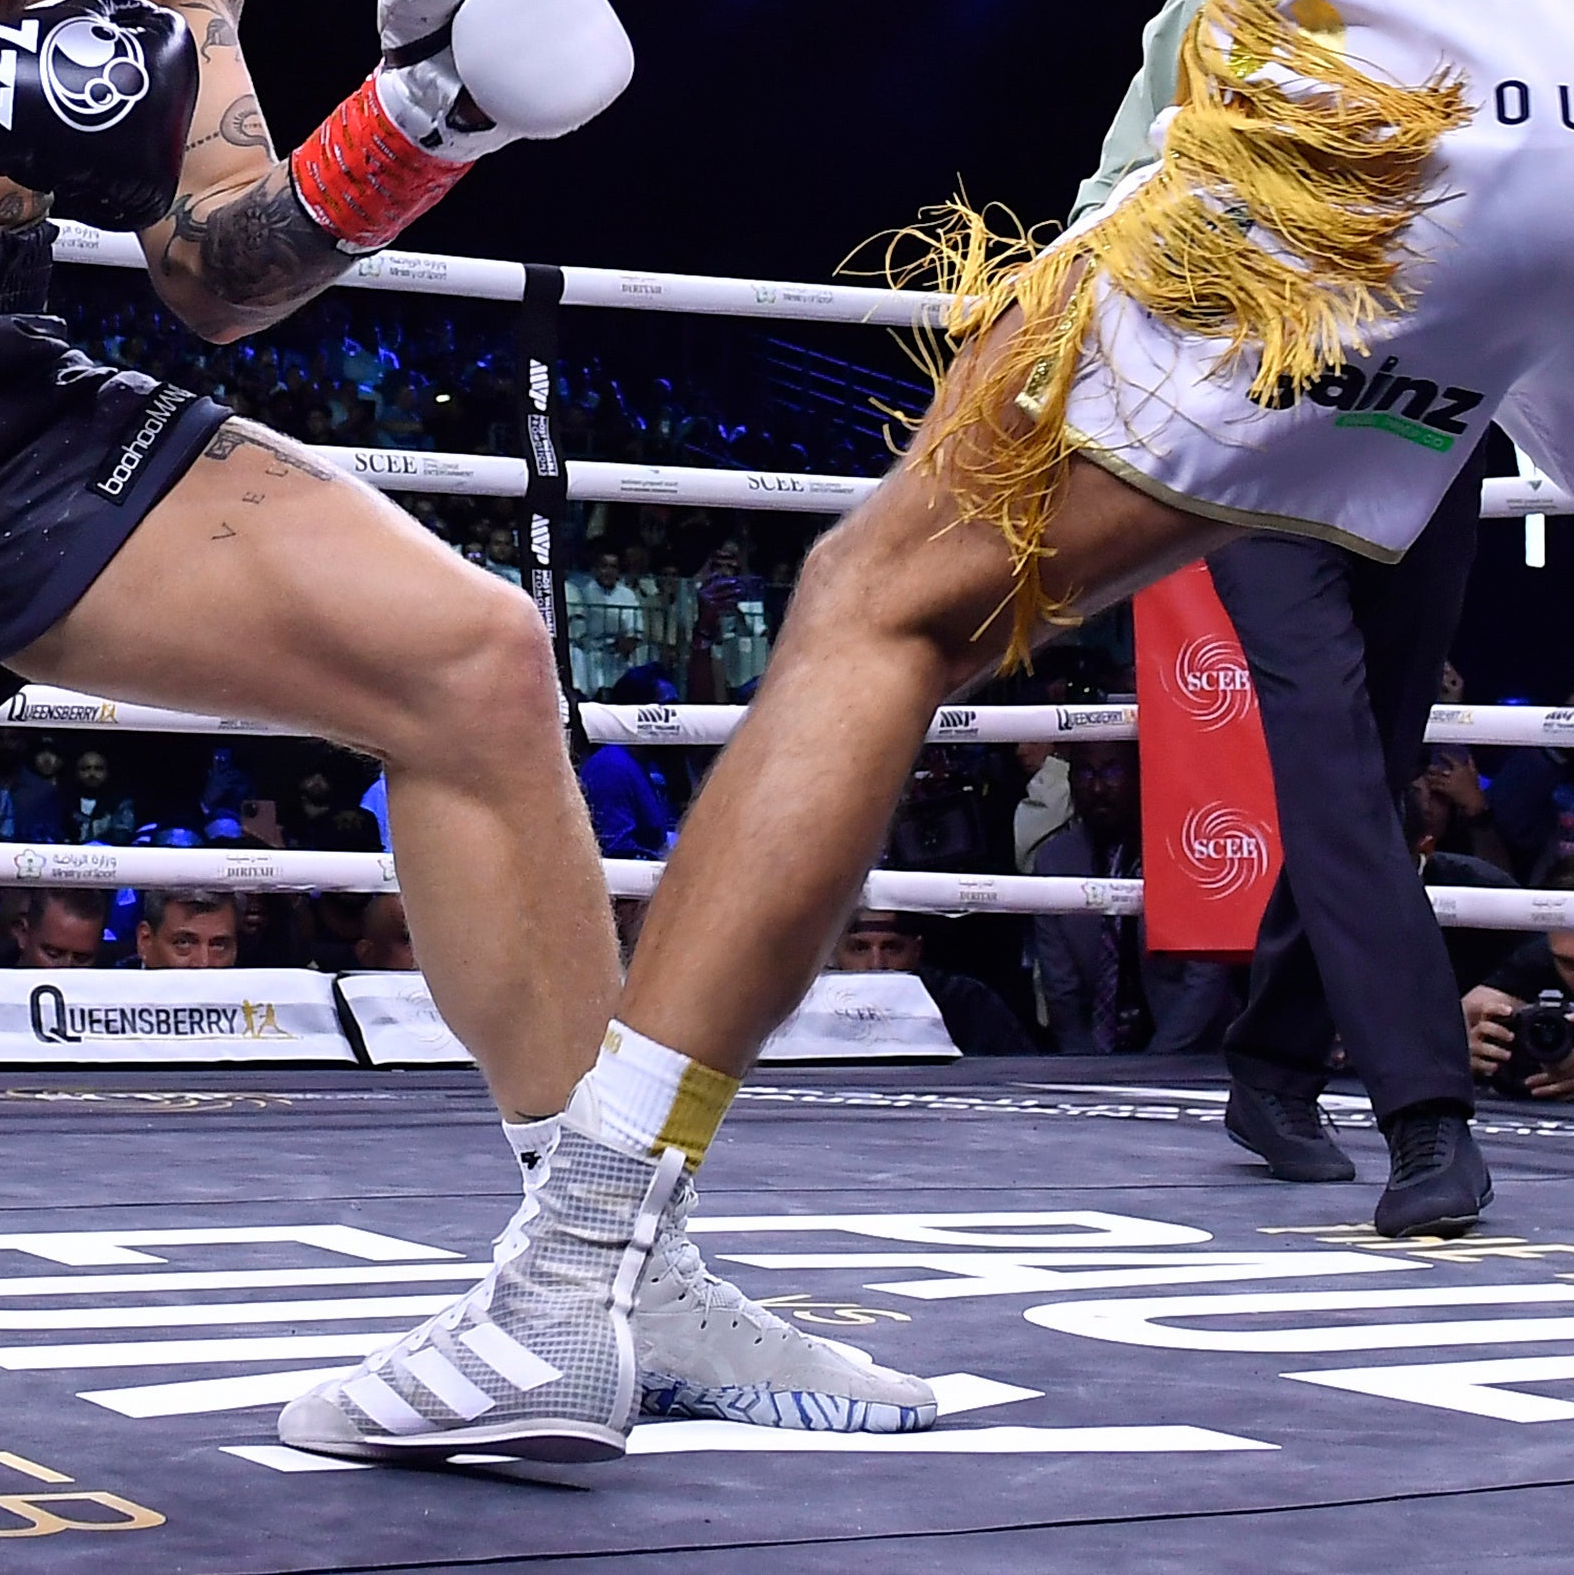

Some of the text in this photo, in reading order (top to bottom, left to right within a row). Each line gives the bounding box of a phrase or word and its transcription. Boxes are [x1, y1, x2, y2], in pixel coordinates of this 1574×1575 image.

[354, 453, 417, 475] SCEE
[1187, 669, 1251, 693] SCEE
[8, 692, 99, 722] QUEENSBERRY
[1193, 838, 1258, 859] SCEE
[227, 867, 274, 878] DIRIYAH
[31, 984, 237, 1042] QUEENSBERRY
